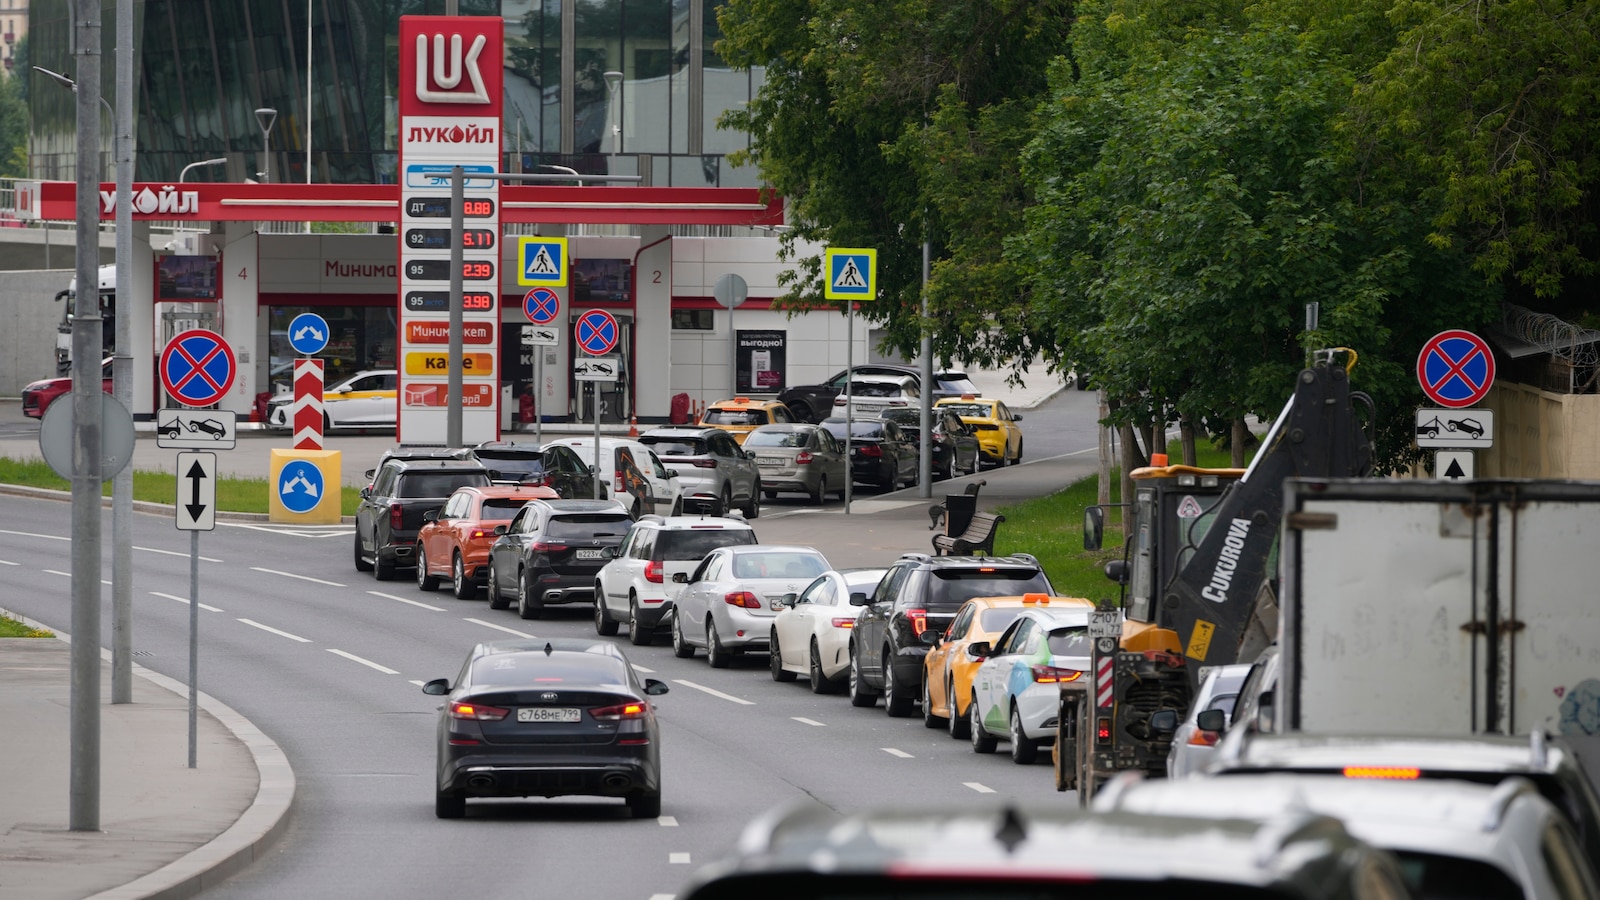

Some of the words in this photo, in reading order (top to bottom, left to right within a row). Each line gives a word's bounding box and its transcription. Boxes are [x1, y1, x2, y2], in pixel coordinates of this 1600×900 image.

[408, 124, 494, 144] ЛУКОЙЛ
[99, 184, 199, 214] УОЙЛ
[411, 202, 425, 213] ДТ
[463, 202, 491, 215] 8.88
[411, 234, 424, 244] 92
[463, 232, 491, 246] 5.11
[238, 267, 248, 280] 4
[411, 265, 424, 275] 95
[463, 264, 491, 277] 2.39
[652, 270, 662, 284] 2
[411, 296, 424, 306] 95
[463, 295, 490, 309] 3.98
[412, 325, 487, 338] Минимкет
[740, 339, 783, 348] выгодно!
[425, 357, 473, 369] кае
[1092, 613, 1118, 624] 2107
[1110, 624, 1120, 633] 77
[1100, 640, 1112, 649] 40
[562, 709, 579, 719] 799
